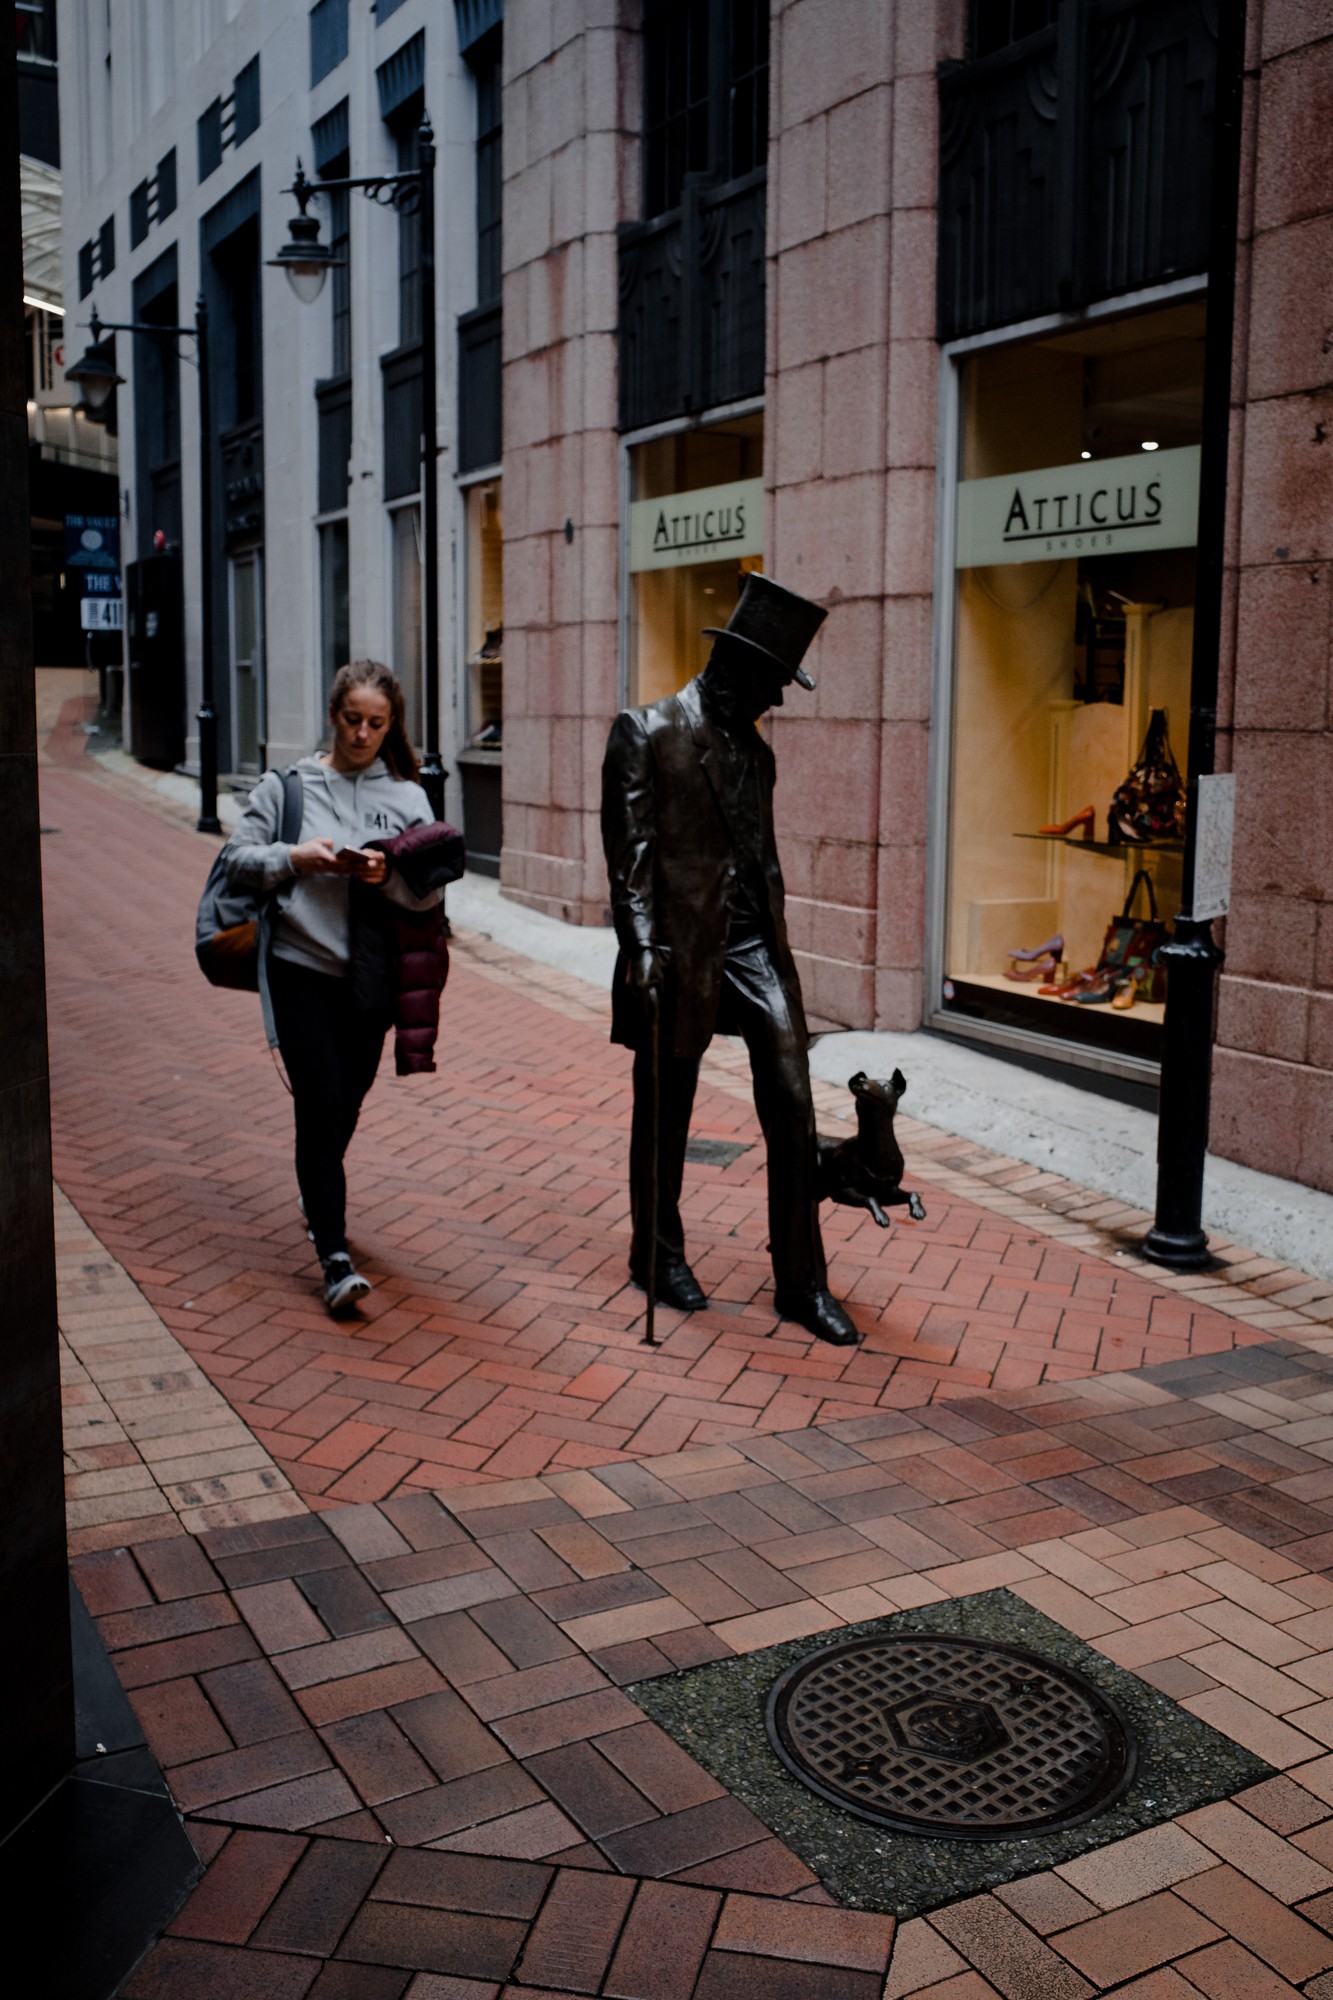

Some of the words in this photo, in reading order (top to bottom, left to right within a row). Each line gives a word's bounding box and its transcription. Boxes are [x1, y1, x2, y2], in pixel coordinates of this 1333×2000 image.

[1004, 482, 1162, 533] ATTICUS
[1046, 535, 1114, 552] SHOES
[86, 573, 111, 592] THE
